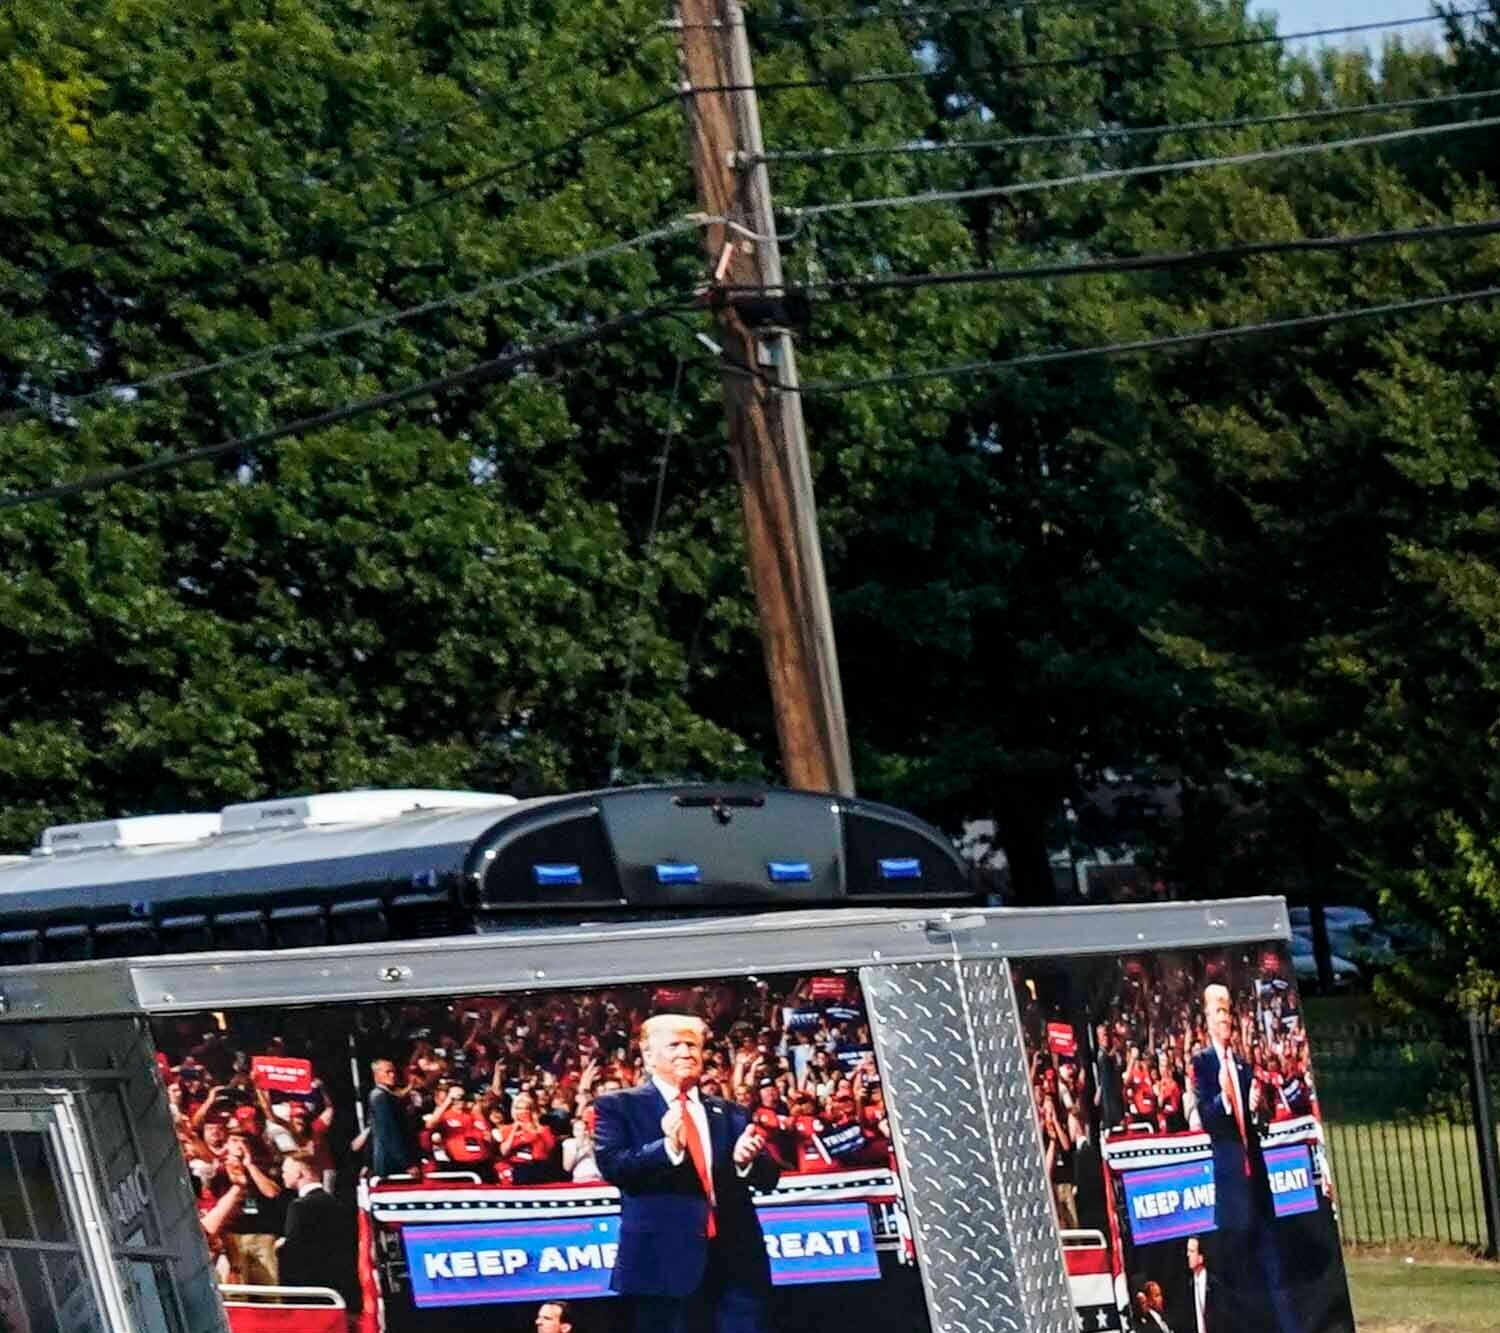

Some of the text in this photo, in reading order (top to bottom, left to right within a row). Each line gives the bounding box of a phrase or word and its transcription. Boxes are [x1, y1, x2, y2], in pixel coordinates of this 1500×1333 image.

[823, 1125, 861, 1147] TRUMP
[1132, 1190, 1179, 1219] KEEP
[1268, 1167, 1309, 1194] EAT!
[424, 1248, 529, 1280] KEEP
[764, 1229, 860, 1259] REAT!
